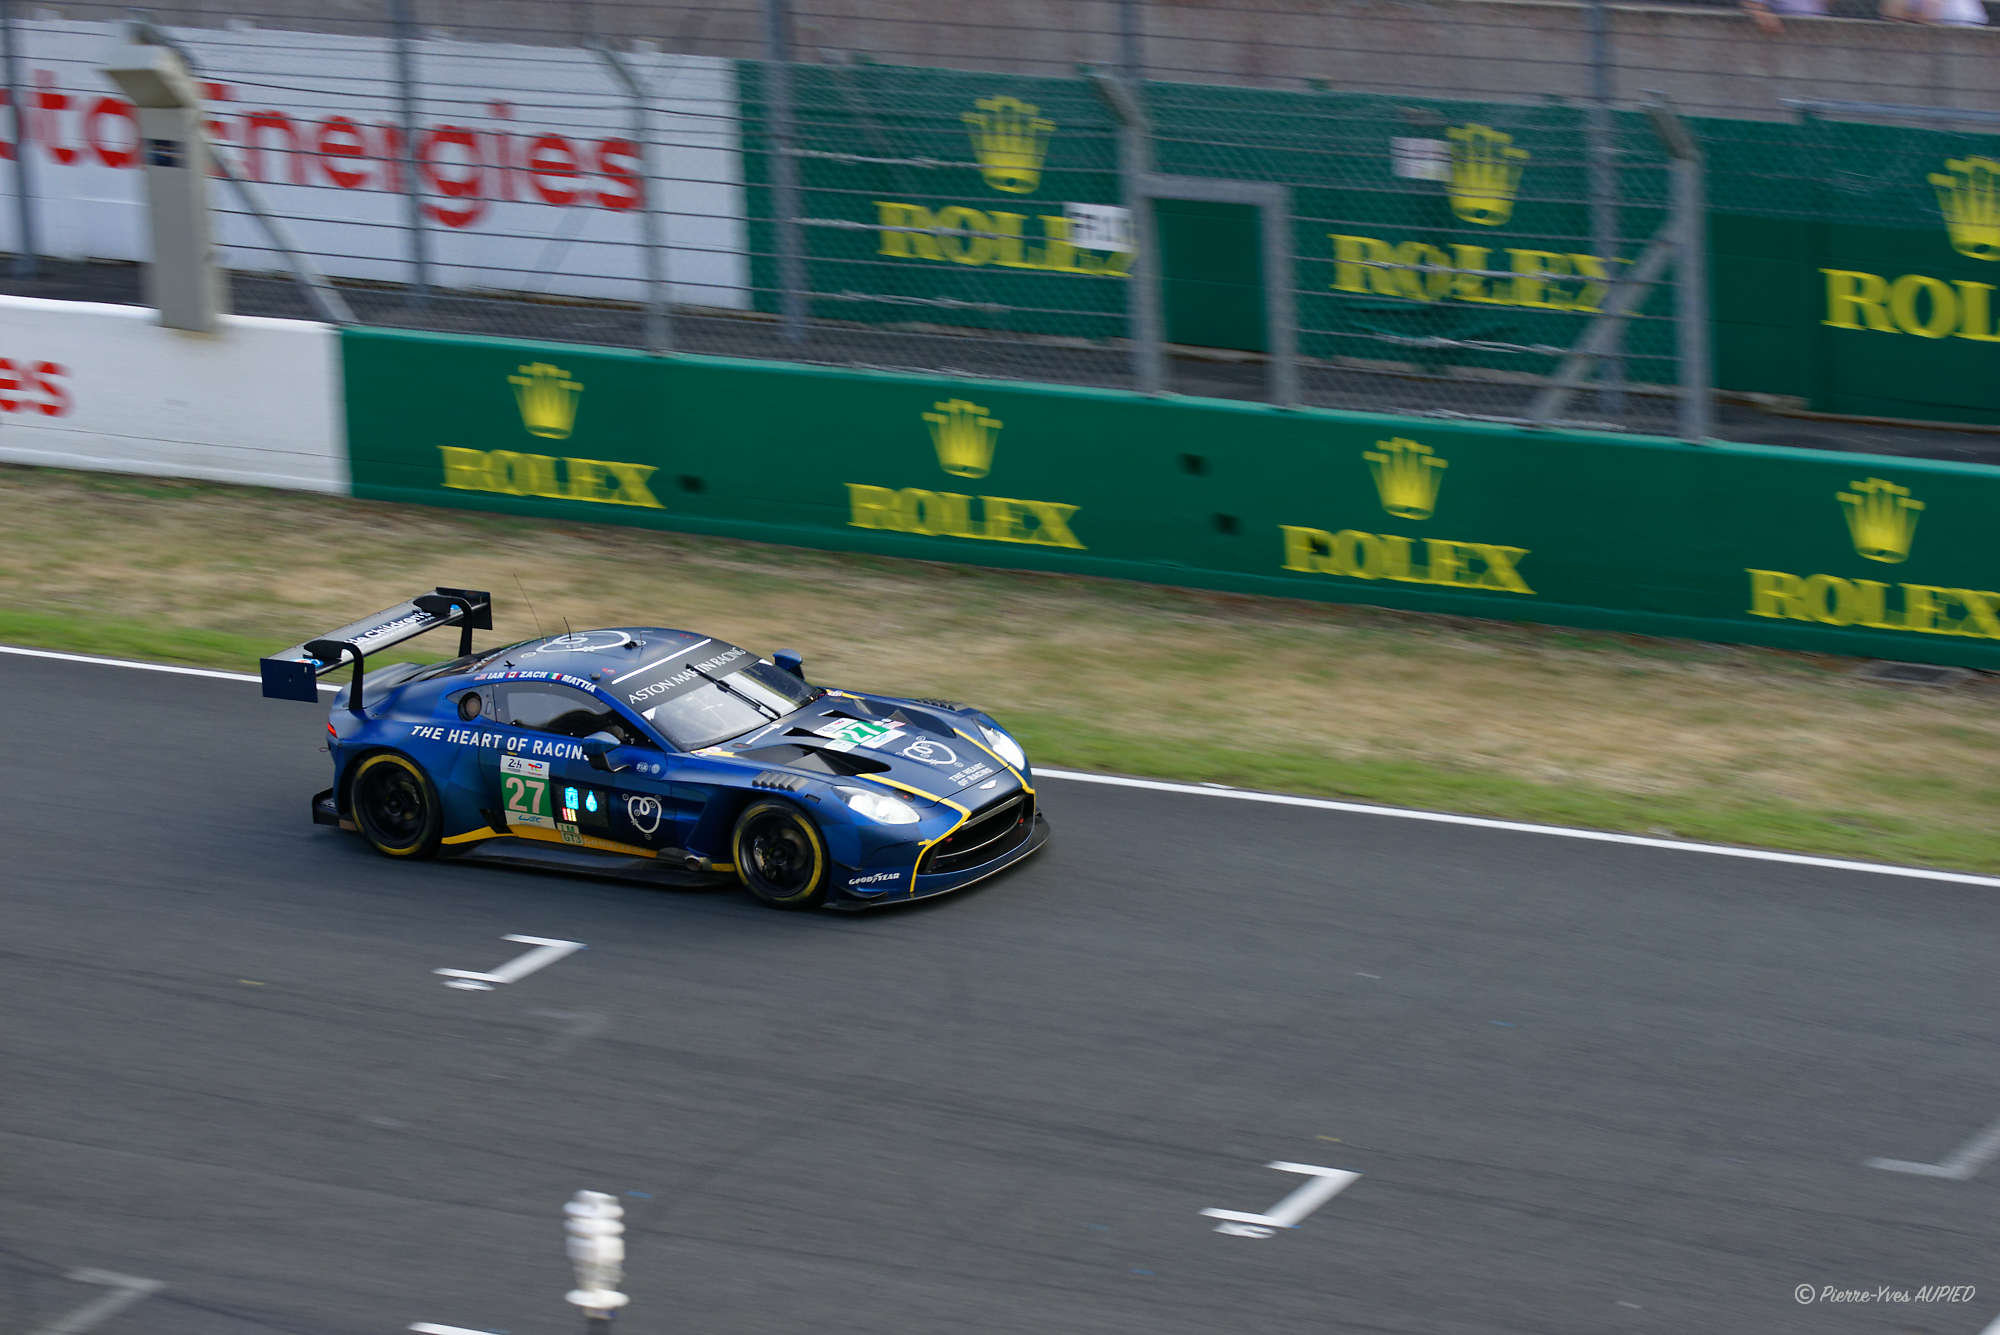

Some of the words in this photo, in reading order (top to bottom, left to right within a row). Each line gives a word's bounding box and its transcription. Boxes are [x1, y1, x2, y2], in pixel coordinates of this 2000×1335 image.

[437, 445, 666, 509] ROLEX
[844, 482, 1087, 550] ROLEX
[1279, 524, 1537, 595] ROLEX
[1744, 567, 2000, 640] ROLEX
[561, 674, 597, 693] MATTIA
[628, 672, 673, 704] ASTON
[411, 725, 444, 740] THE
[447, 729, 502, 748] HEART
[506, 736, 528, 752] OF
[506, 776, 545, 814] 27
